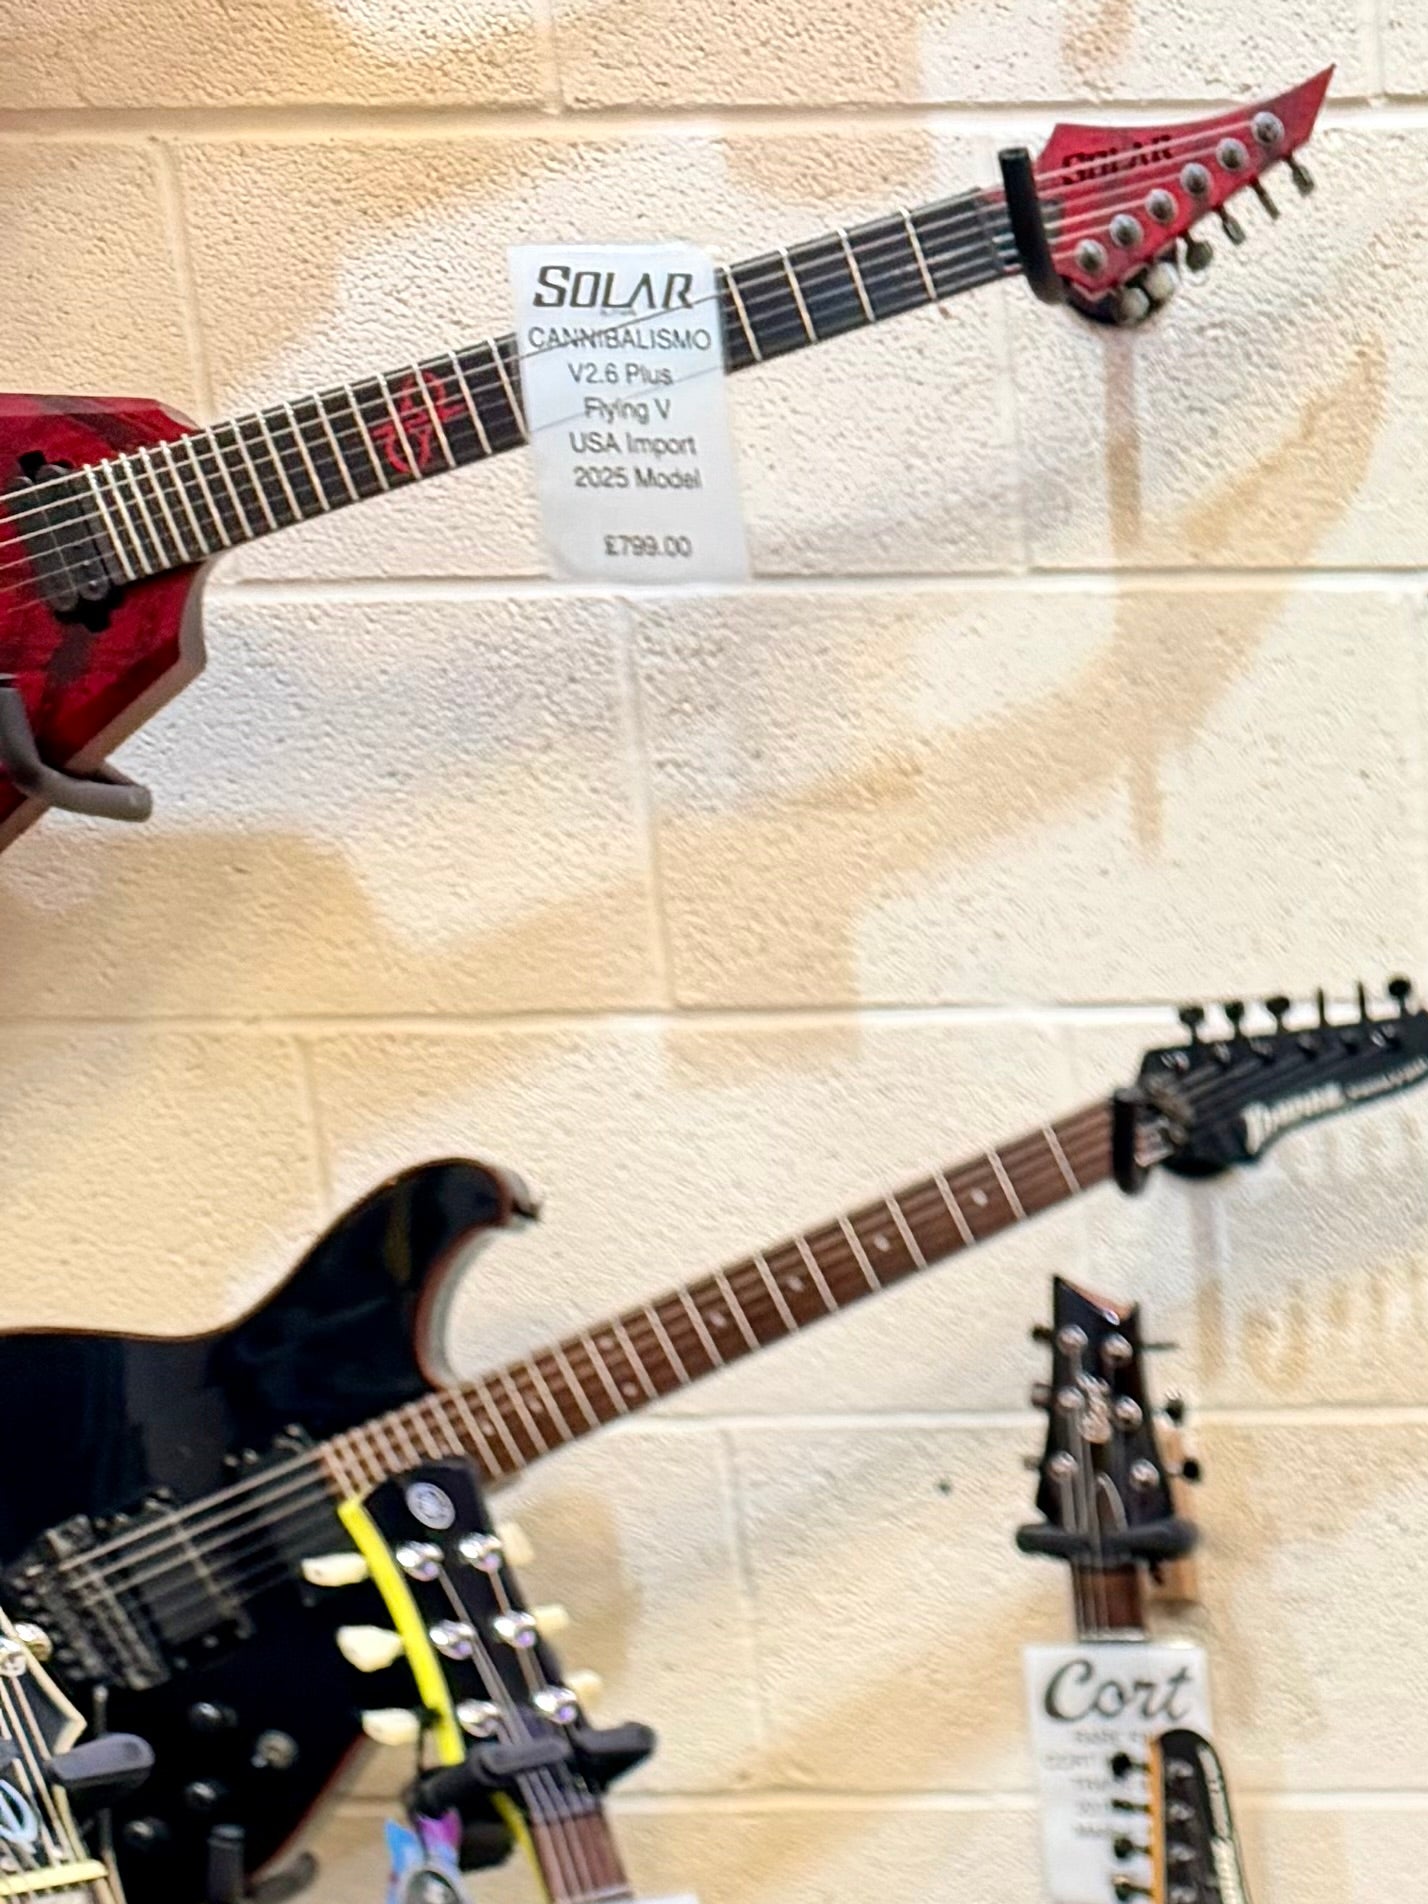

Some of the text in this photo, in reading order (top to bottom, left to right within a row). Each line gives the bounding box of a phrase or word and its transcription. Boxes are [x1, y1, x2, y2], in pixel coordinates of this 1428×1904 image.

[533, 265, 694, 309] SOLAR
[528, 327, 712, 351] CANNIBALISMO
[568, 363, 674, 384] V2.6 Plus
[584, 398, 671, 422] Flying V
[570, 432, 697, 457] USA Import
[574, 467, 702, 489] 2025 Model
[604, 534, 693, 557] £799.00
[1044, 1659, 1193, 1723] Cort
